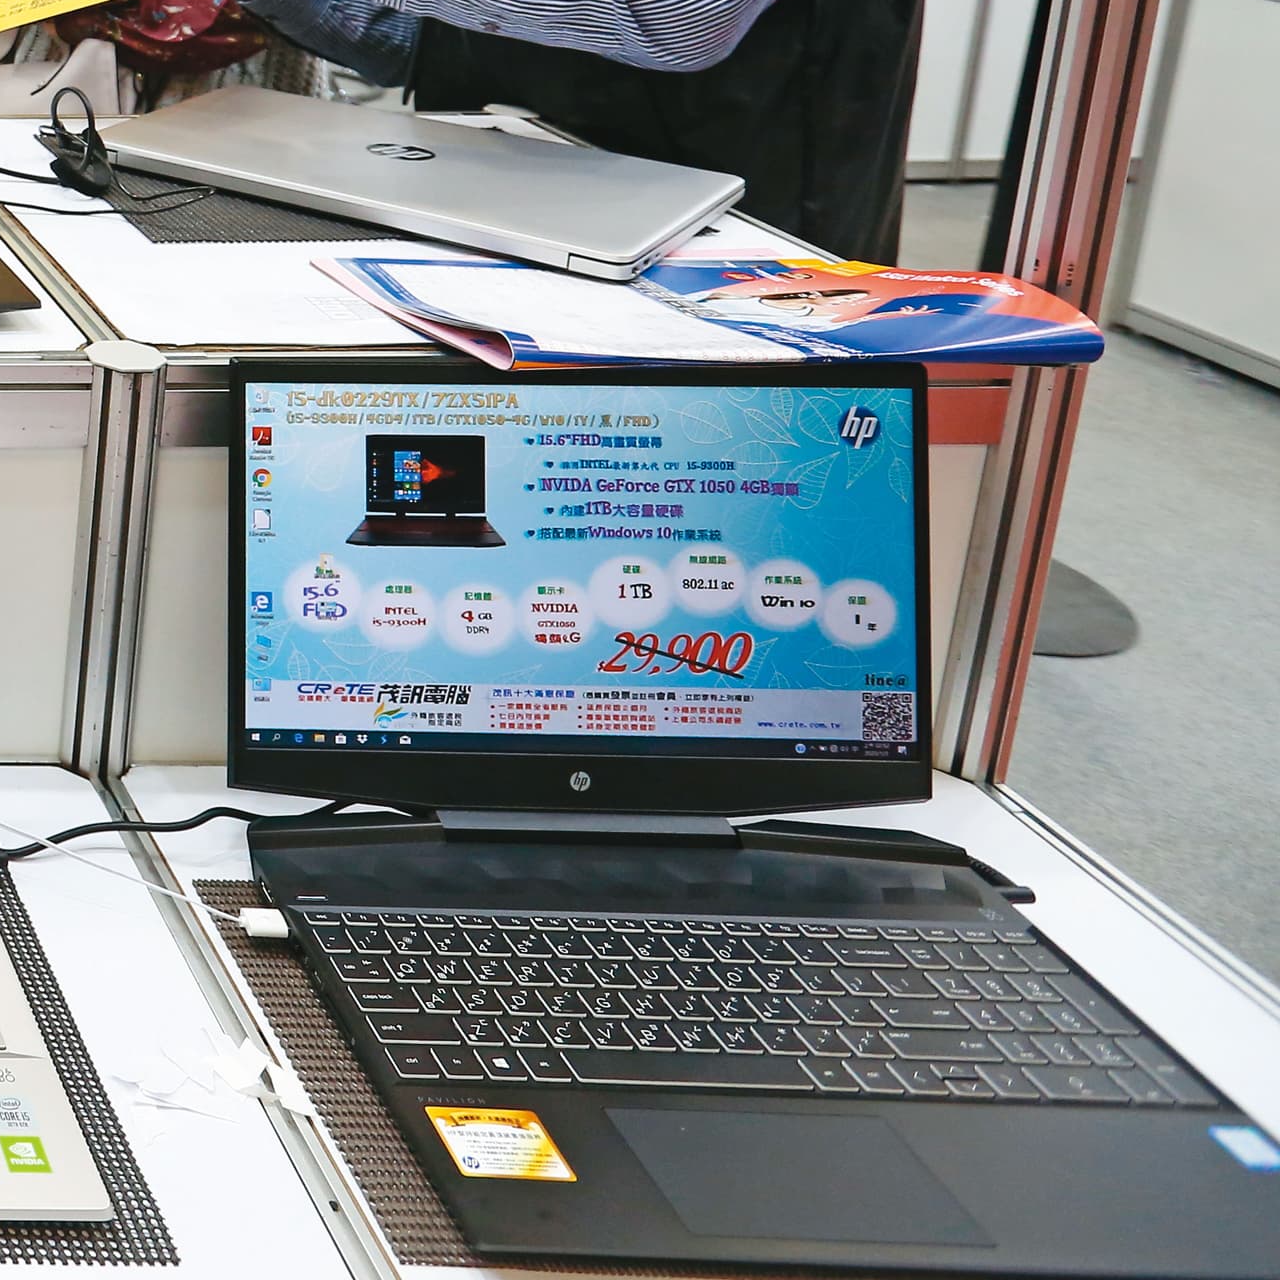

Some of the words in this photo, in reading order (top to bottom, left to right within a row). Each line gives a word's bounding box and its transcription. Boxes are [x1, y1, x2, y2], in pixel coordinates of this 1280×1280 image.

[839, 406, 881, 449] hp
[664, 461, 680, 471] CPU
[540, 478, 593, 494] NVIDA
[596, 479, 660, 494] GeForce
[664, 479, 695, 494] GTX
[699, 479, 736, 494] 1050
[559, 502, 685, 518] 內建1TB大容量硬碟
[539, 526, 653, 541] 搭配最新Windows
[656, 527, 722, 543] 10作業系統
[630, 583, 653, 599] TB
[682, 578, 719, 590] 802.11
[721, 581, 735, 590] ac
[531, 603, 578, 614] NVIDIA
[760, 594, 793, 609] Win
[800, 598, 816, 609] 10
[384, 607, 418, 616] INTEL
[598, 630, 754, 676] $29,900
[864, 673, 908, 687] line@
[377, 684, 472, 705] 茂訊電腦
[570, 771, 592, 793] hp
[0, 1112, 21, 1121] CORE
